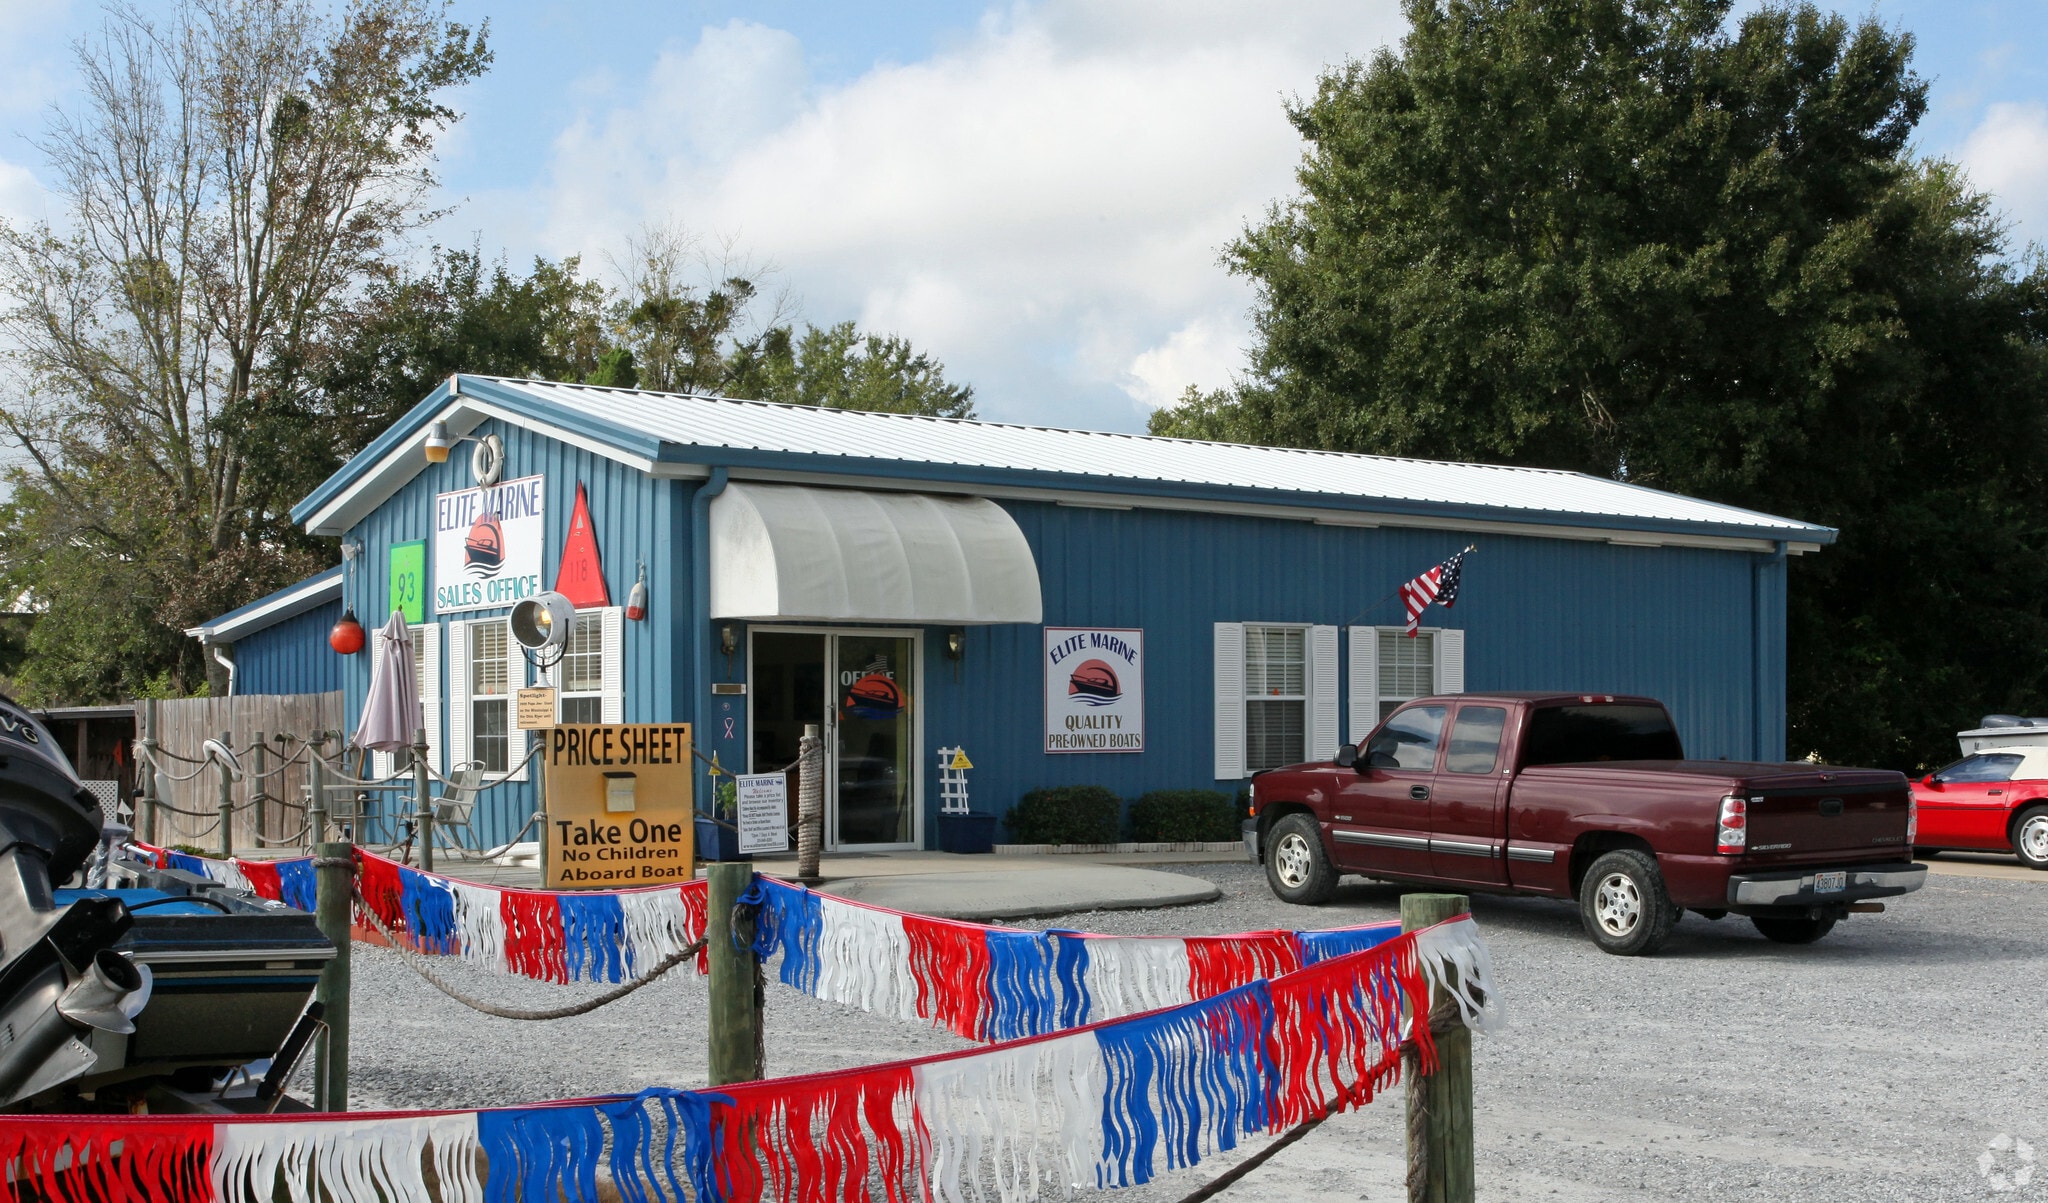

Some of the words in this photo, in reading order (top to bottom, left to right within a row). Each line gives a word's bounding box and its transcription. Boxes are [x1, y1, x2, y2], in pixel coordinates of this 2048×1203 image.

[438, 492, 477, 532] ELITE
[482, 480, 540, 522] MARINE
[570, 558, 587, 583] 118
[398, 571, 415, 602] 93
[437, 581, 482, 608] SALES
[487, 575, 538, 602] OFFICE
[1049, 633, 1086, 665] ELITE
[1090, 632, 1138, 666] MARINE
[1065, 715, 1123, 732] QUALITY
[553, 728, 613, 766] PRICE
[620, 727, 685, 765] SHEET
[1049, 733, 1106, 748] PRE-OWNED
[1110, 733, 1141, 748] BOATS
[556, 819, 622, 846] Take
[629, 819, 682, 844] One
[563, 850, 591, 862] No
[596, 847, 679, 861] Children
[560, 866, 636, 881] Aboard
[642, 865, 684, 878] Boat
